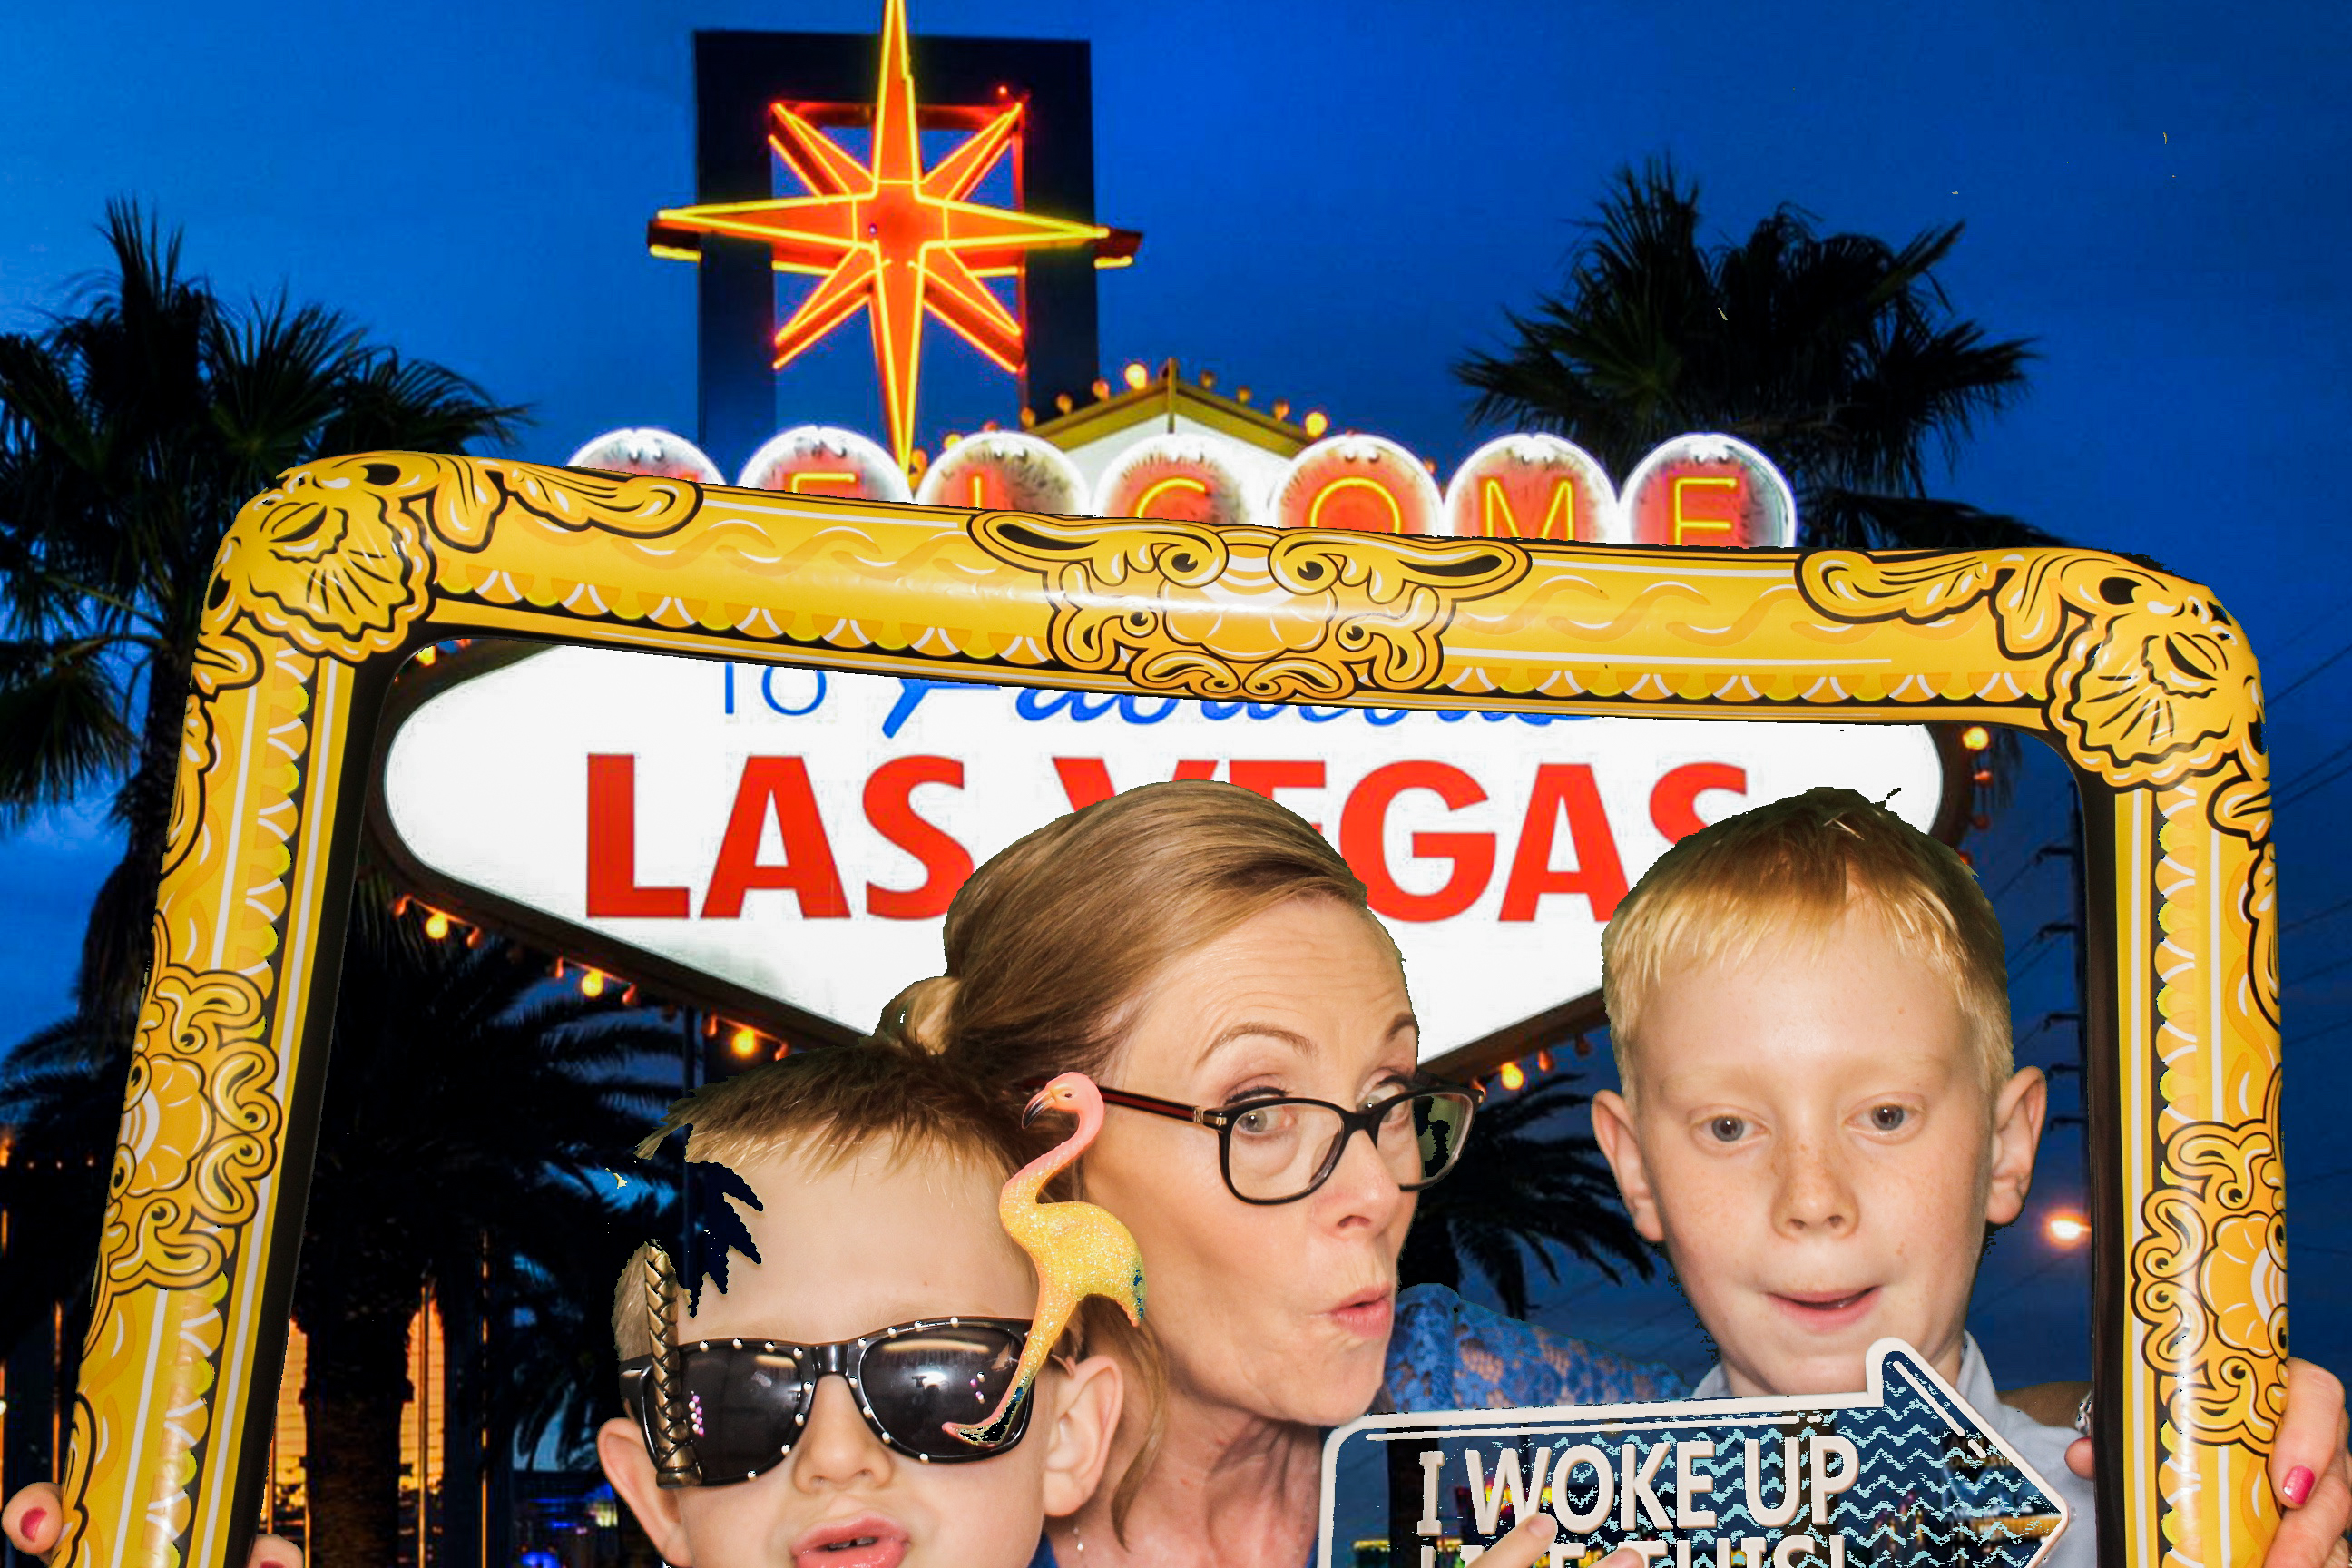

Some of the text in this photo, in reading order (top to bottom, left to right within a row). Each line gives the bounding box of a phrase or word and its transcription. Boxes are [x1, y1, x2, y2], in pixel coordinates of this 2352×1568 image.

[587, 753, 975, 920] LAS
[1416, 1436, 1859, 1536] I WOKE UP
